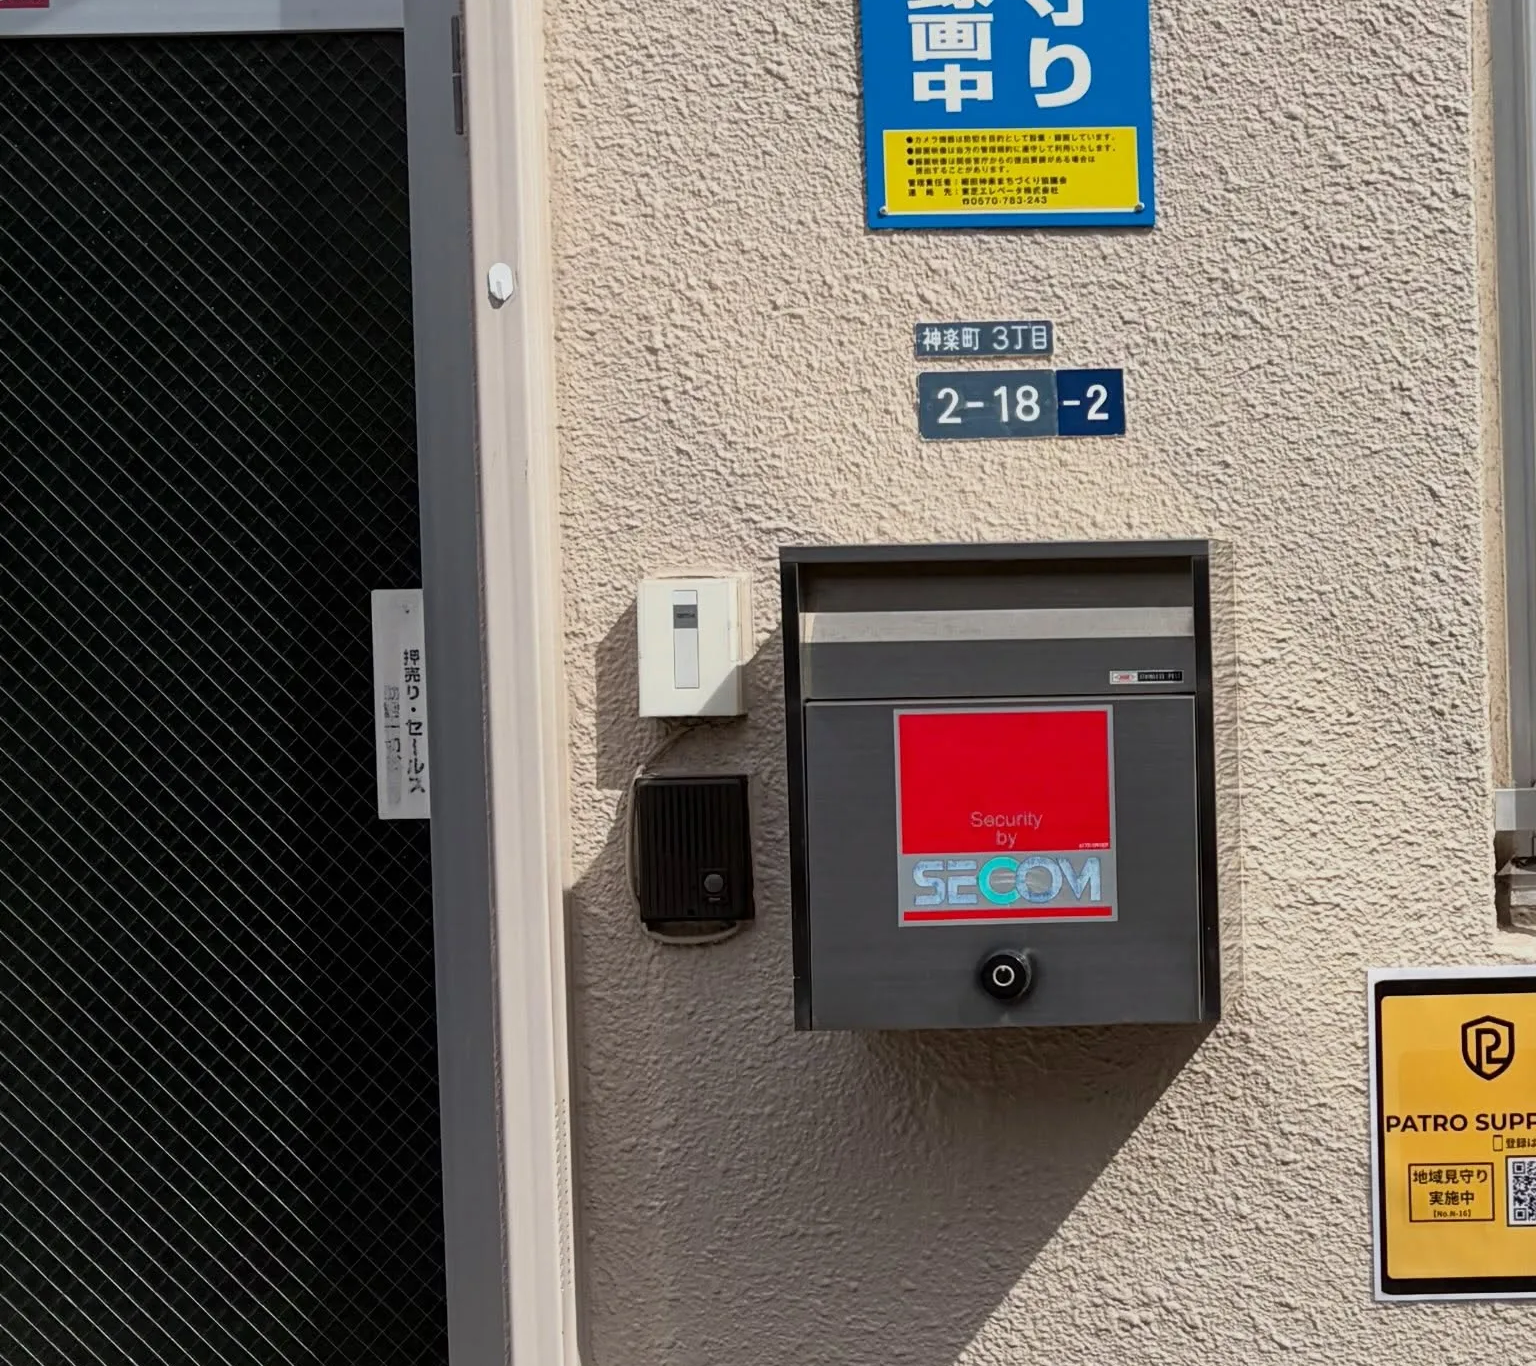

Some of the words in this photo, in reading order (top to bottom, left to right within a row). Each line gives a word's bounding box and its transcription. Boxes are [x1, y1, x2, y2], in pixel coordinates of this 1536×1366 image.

[921, 326, 981, 352] 神楽町
[991, 325, 1048, 351] 3丁目
[936, 385, 1041, 424] 2-18
[402, 648, 426, 794] 押売り・セールス
[970, 811, 1044, 829] Security
[995, 830, 1018, 848] by
[912, 855, 1102, 906] SECOM
[1386, 1114, 1468, 1132] PATRO
[1412, 1168, 1489, 1185] 地域見守り
[1428, 1190, 1475, 1206] 実施中
